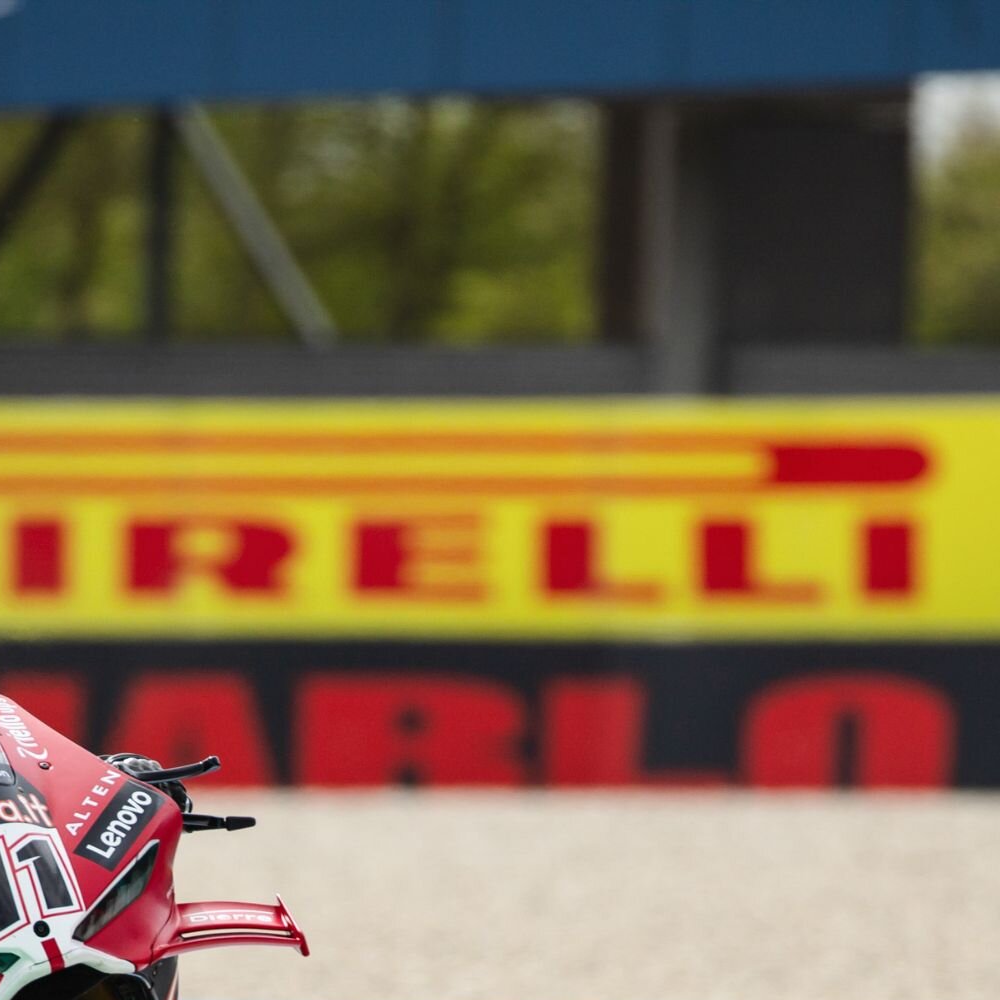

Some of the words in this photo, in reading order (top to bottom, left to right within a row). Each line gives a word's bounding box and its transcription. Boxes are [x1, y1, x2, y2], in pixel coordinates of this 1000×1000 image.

[65, 770, 122, 837] ALTEN
[86, 790, 153, 860] Lenovo
[188, 913, 273, 923] Dierre
